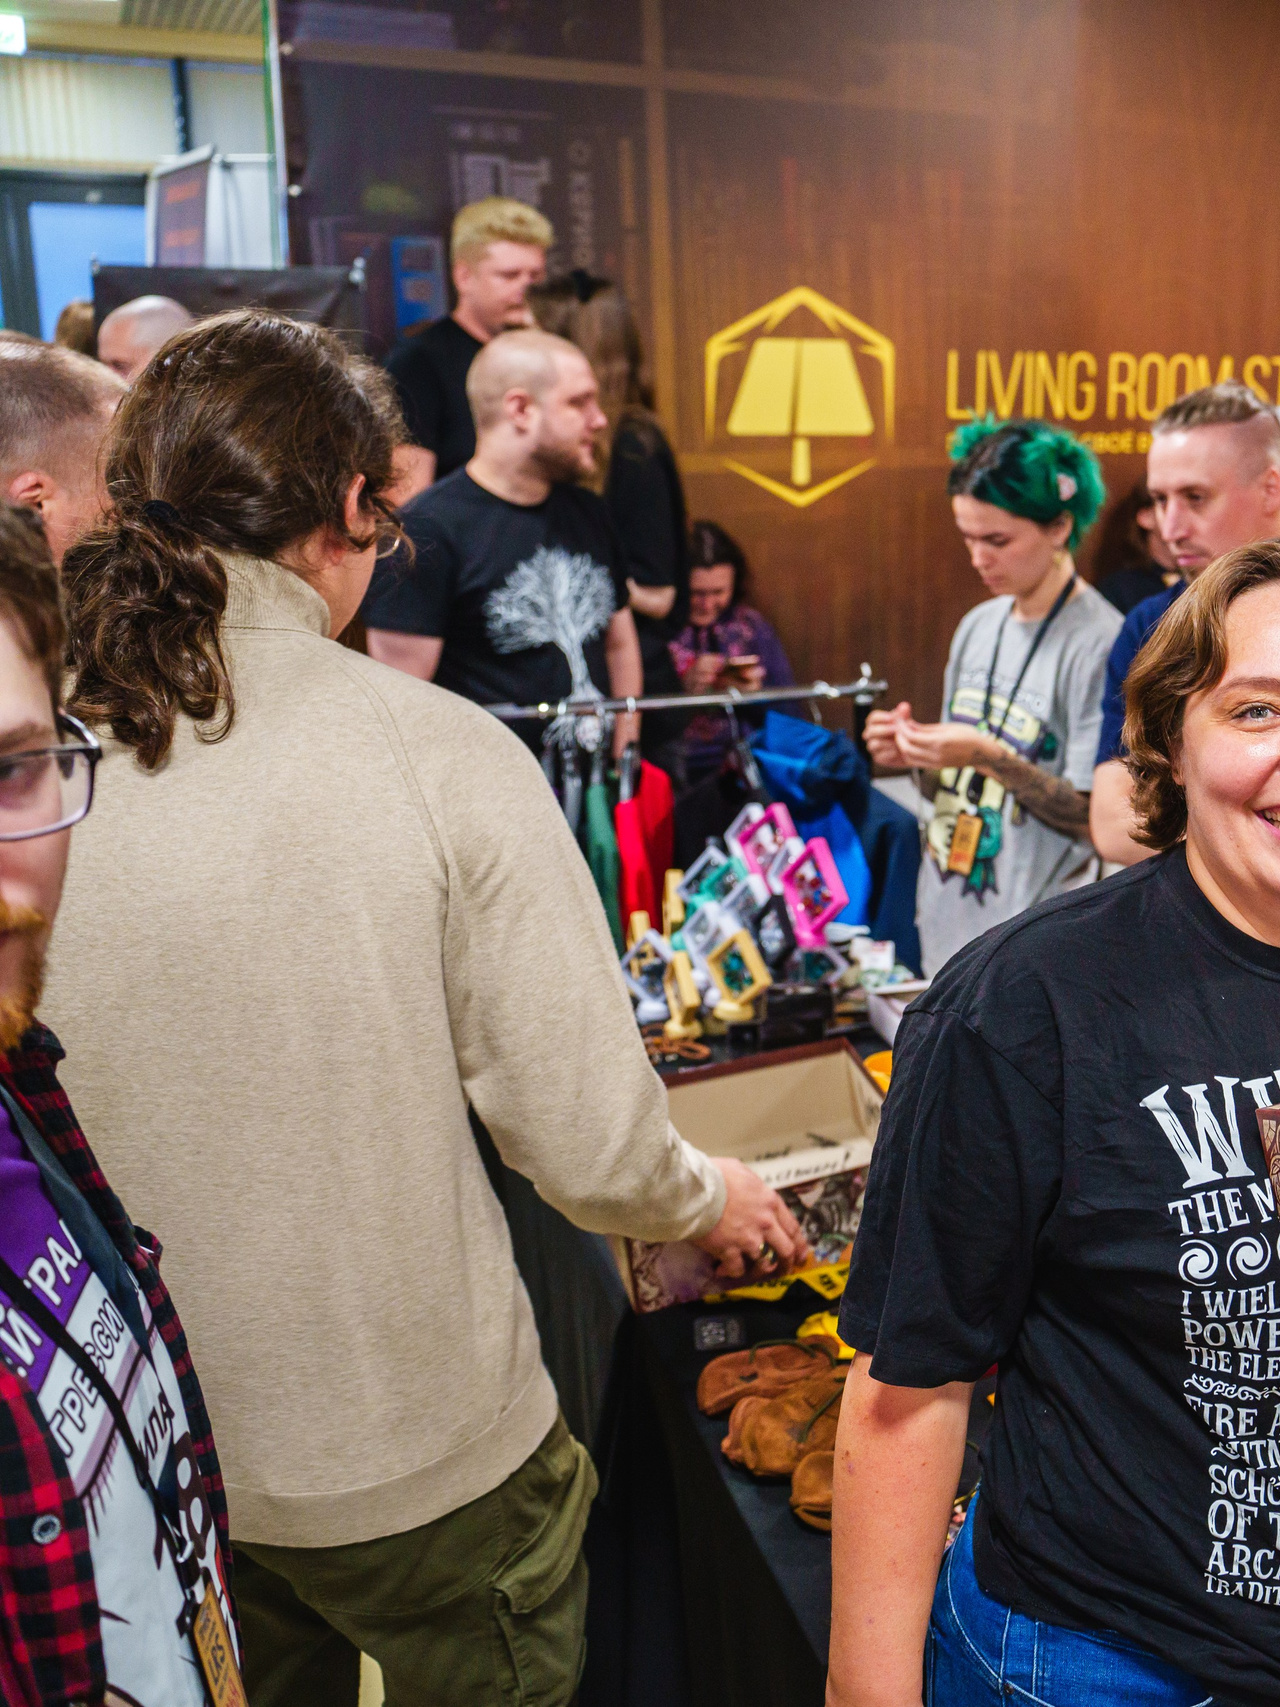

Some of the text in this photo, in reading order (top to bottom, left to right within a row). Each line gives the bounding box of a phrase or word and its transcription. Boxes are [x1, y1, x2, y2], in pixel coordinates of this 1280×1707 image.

[946, 349, 1098, 421] LIVING
[1168, 1187, 1250, 1236] THE
[1181, 1290, 1192, 1315] I
[49, 1298, 125, 1458] ГРЕССИ
[1185, 1346, 1232, 1374] THE
[138, 1391, 175, 1464] ИЛА
[1207, 1499, 1258, 1541] OF
